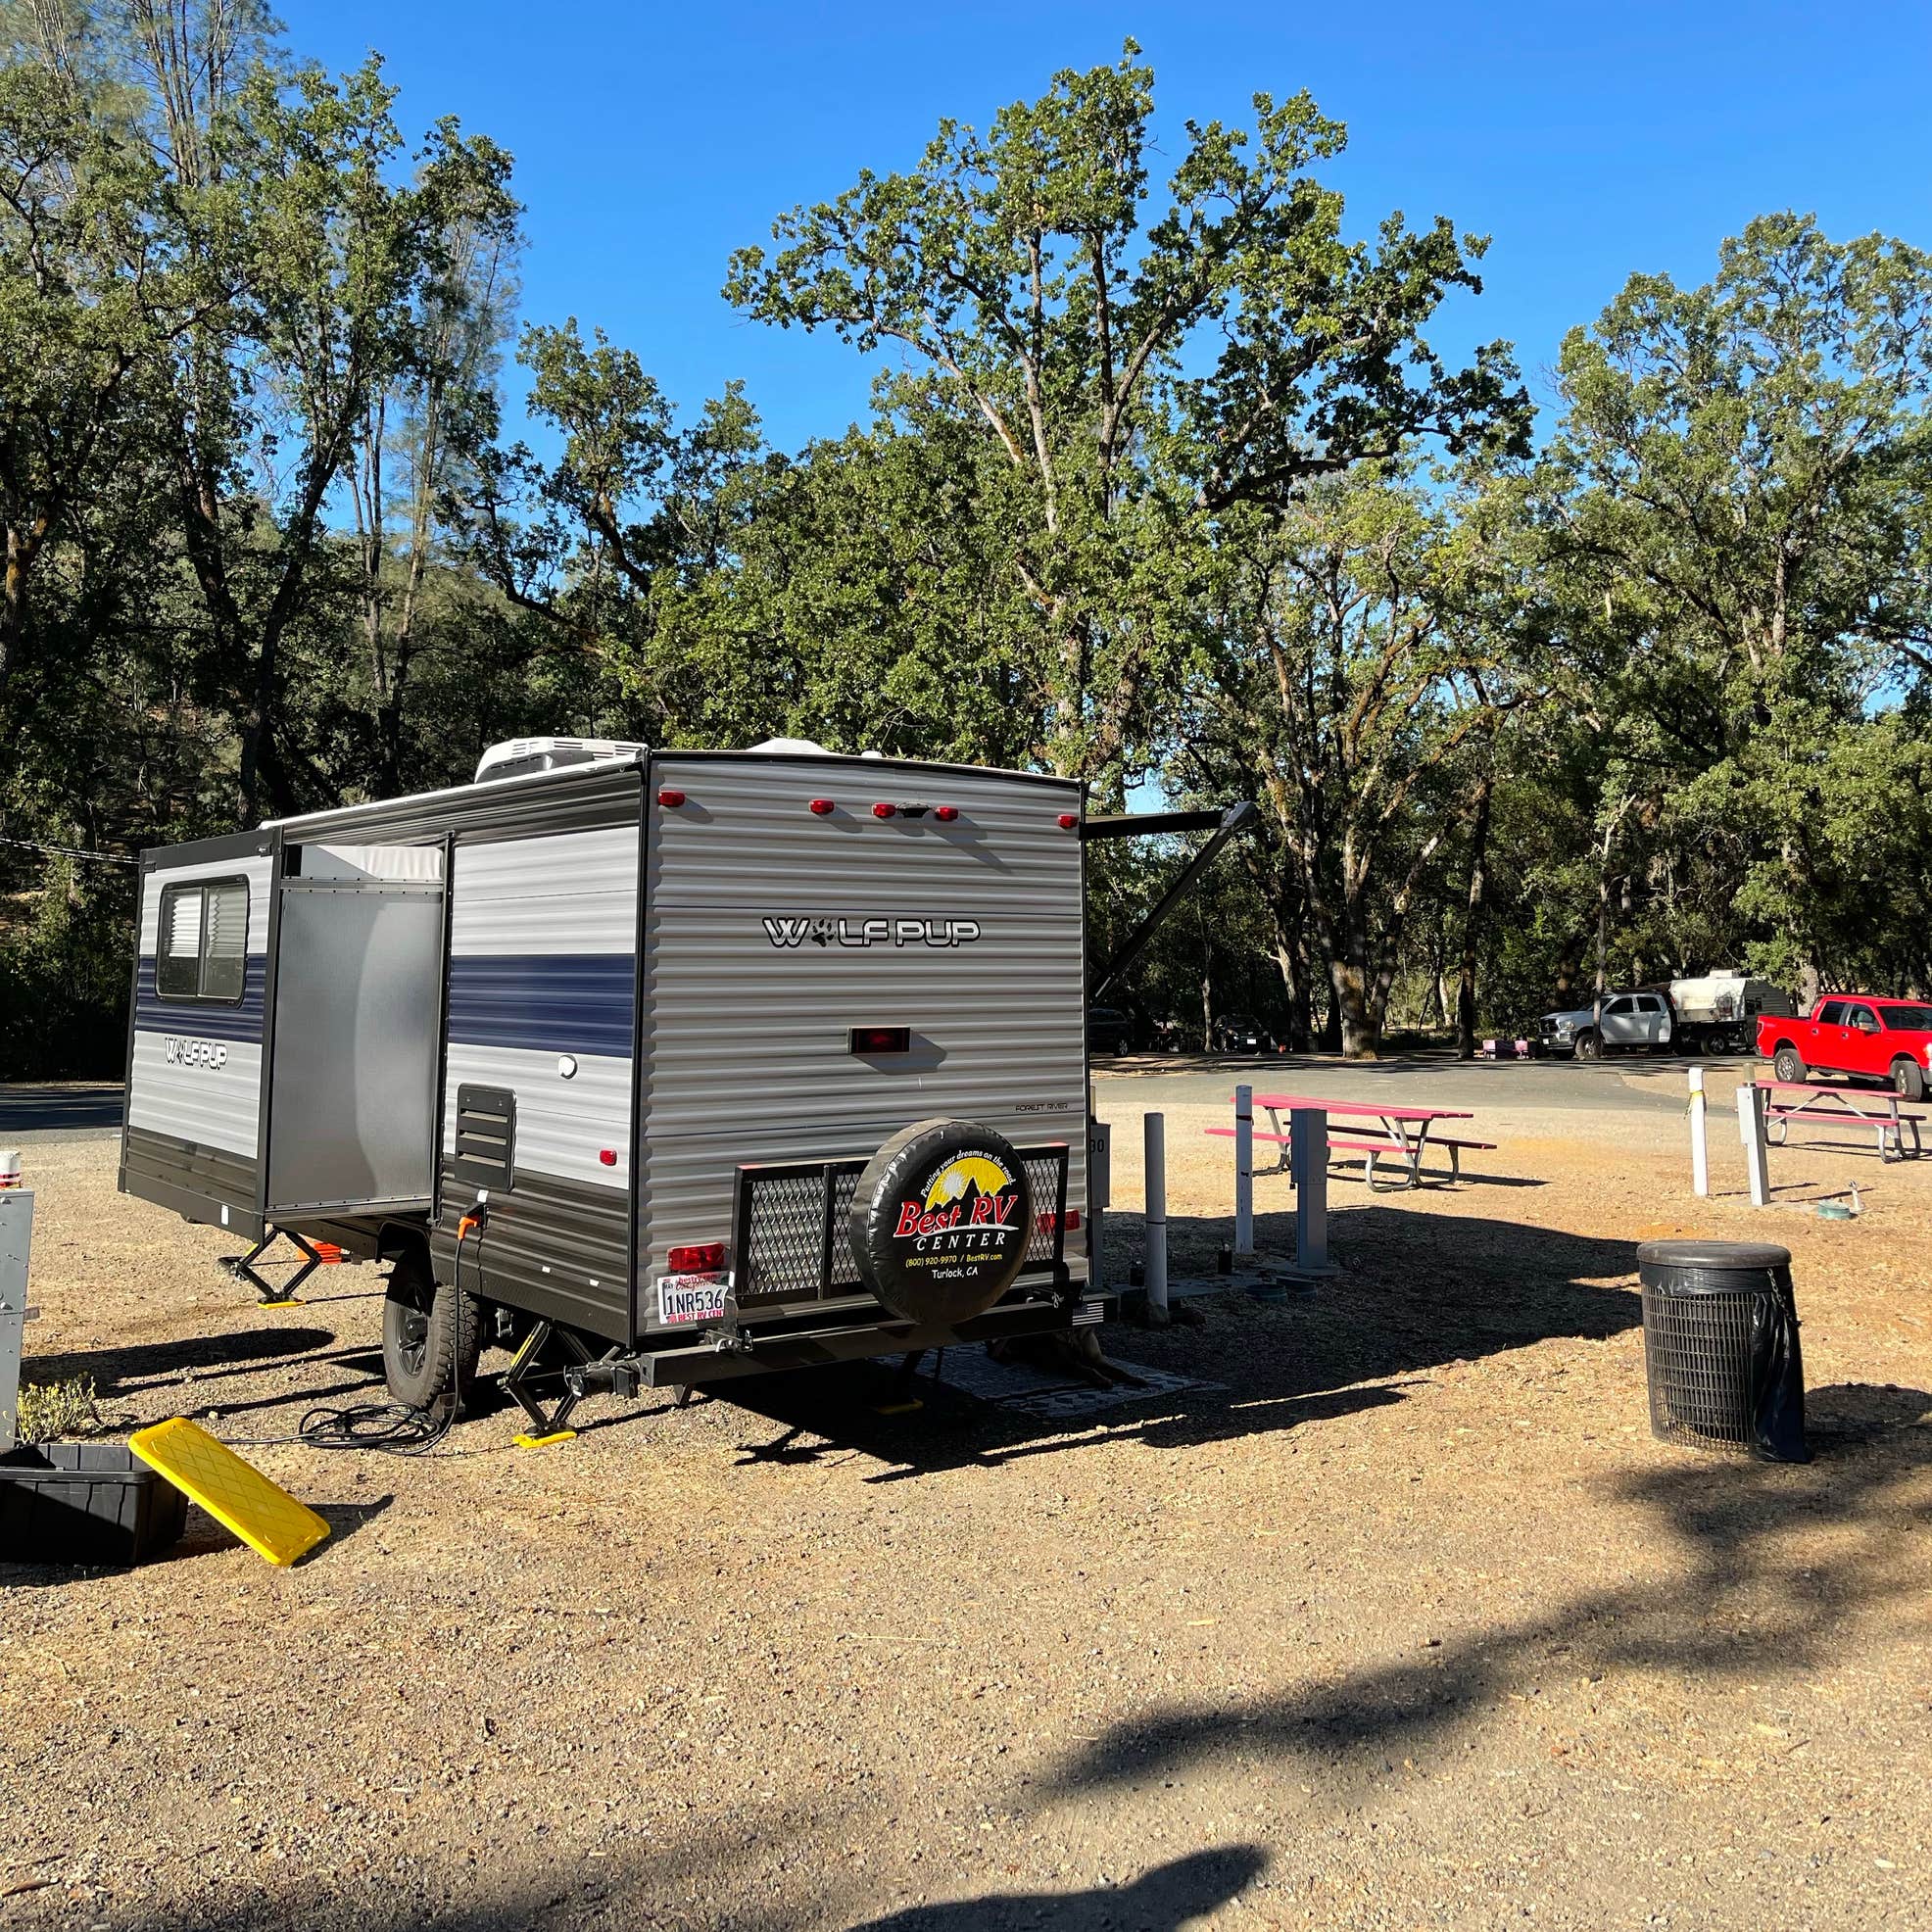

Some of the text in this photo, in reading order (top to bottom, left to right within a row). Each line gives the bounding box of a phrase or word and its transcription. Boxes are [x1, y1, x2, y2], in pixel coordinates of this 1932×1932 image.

[762, 917, 981, 947] WLF PUP
[165, 1037, 228, 1070] WLF PUP
[921, 1166, 942, 1197] Putting
[940, 1156, 956, 1173] your
[956, 1149, 983, 1160] dreams
[992, 1155, 1004, 1168] the
[893, 1195, 1018, 1238] Best RV
[916, 1232, 1005, 1252] CENTER
[905, 1257, 924, 1268] (800)
[925, 1255, 957, 1266] 920-9970
[966, 1253, 1003, 1263] BestRV.com
[932, 1266, 979, 1280] Turlock, CA
[666, 1289, 723, 1315] 1NR536
